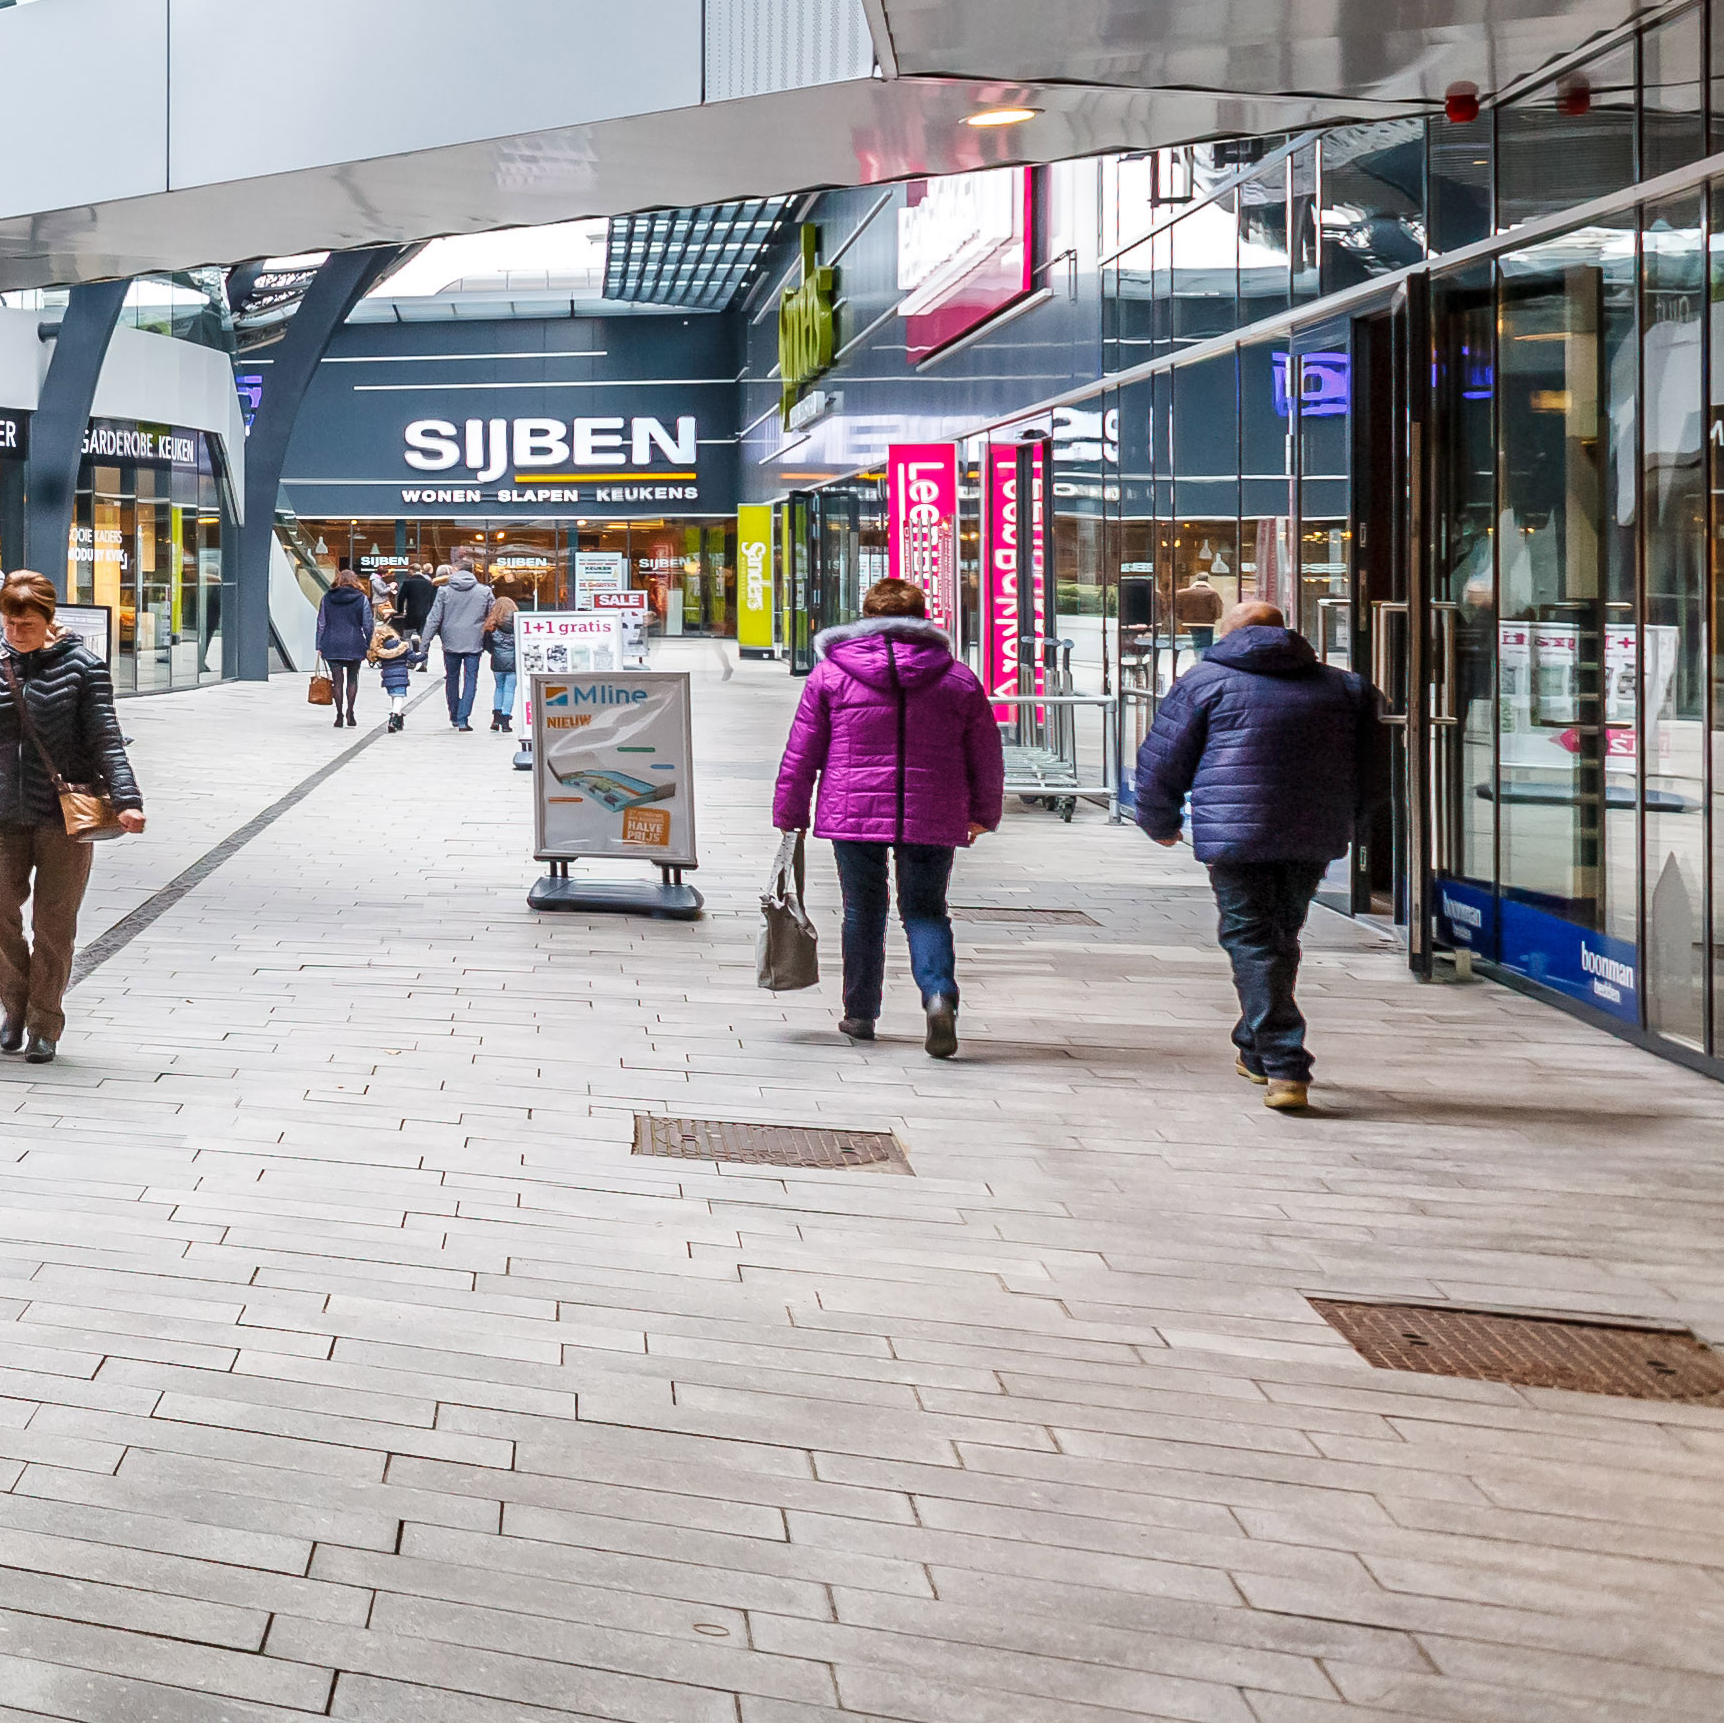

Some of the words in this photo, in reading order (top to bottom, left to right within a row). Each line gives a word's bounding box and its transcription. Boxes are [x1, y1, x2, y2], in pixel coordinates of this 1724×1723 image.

[158, 435, 194, 463] KEUKEN
[404, 416, 697, 482] SIJBEN
[401, 489, 481, 503] WONEN
[497, 489, 579, 503] SLAPEN
[596, 487, 699, 502] KEUKENS
[69, 529, 92, 542] OOIE
[360, 556, 410, 568] SIJBEN
[496, 556, 548, 569] SIJBEN
[639, 556, 691, 570] SIJBEN
[598, 594, 640, 606] SALE
[522, 620, 554, 635] 1+1
[558, 620, 612, 635] gratis
[546, 714, 592, 729] NIEUW
[628, 820, 664, 833] HALVE
[627, 830, 662, 842] PRIJS
[1581, 941, 1634, 989] boonman
